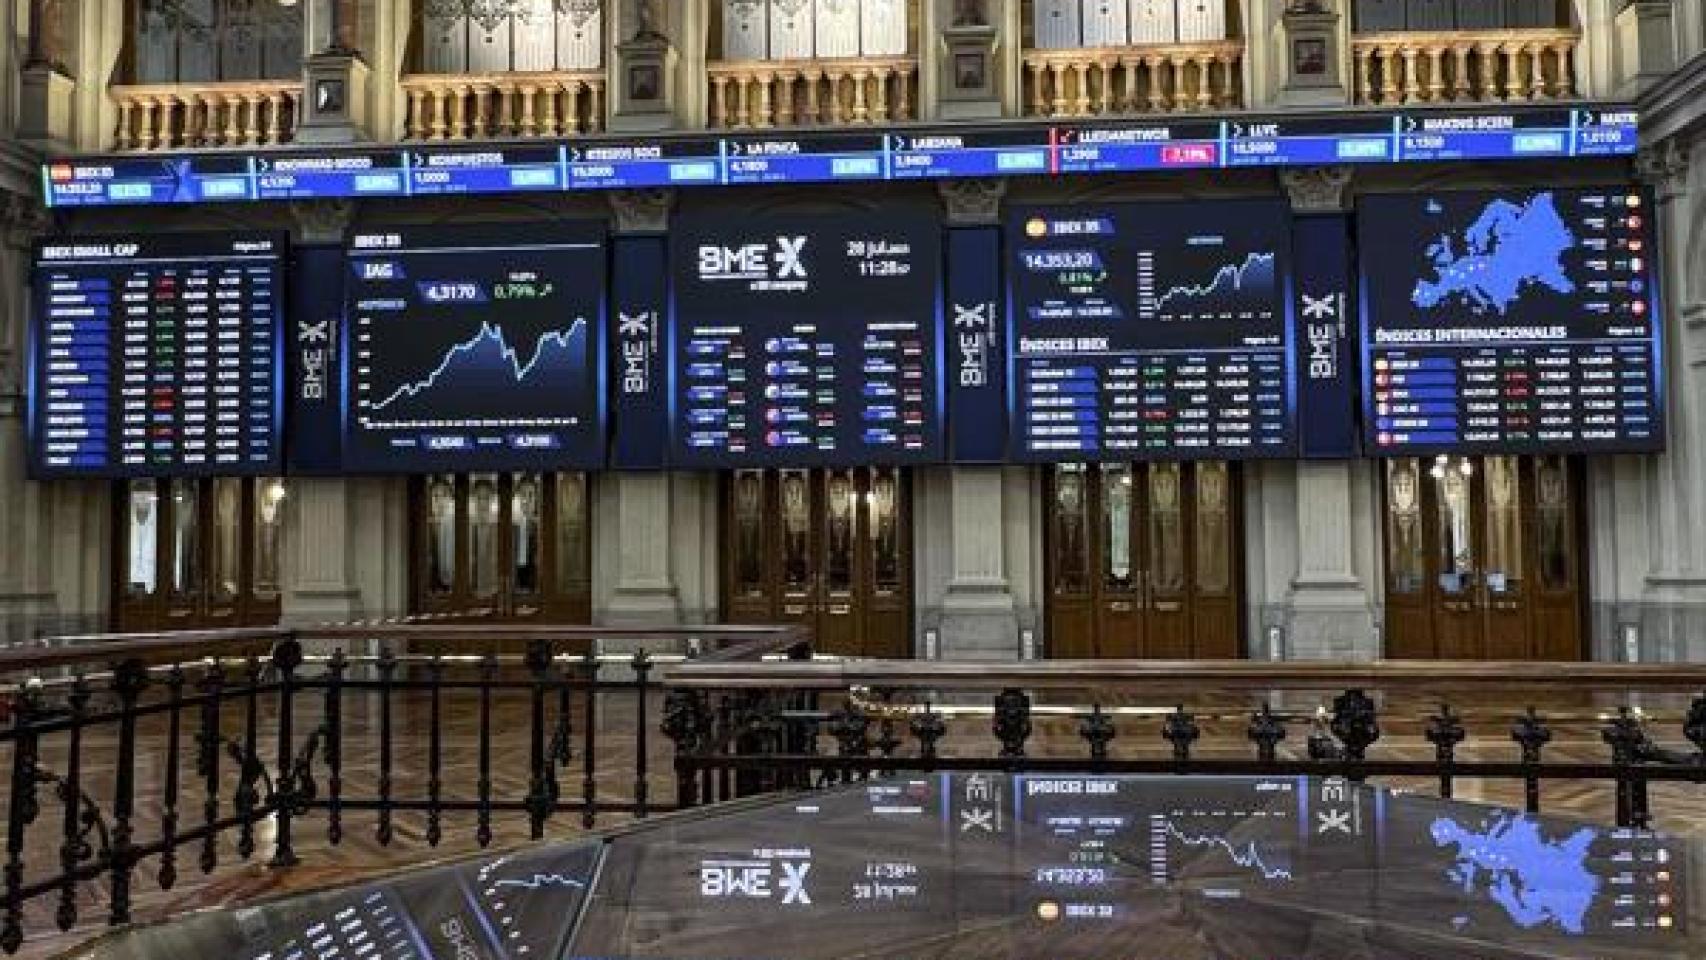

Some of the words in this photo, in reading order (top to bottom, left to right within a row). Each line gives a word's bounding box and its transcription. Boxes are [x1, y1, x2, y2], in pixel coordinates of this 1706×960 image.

[363, 263, 393, 279] IAG
[699, 243, 768, 273] BME
[303, 349, 322, 399] BME
[623, 340, 644, 393] BME
[960, 332, 982, 387] BME
[1308, 323, 1332, 379] BME
